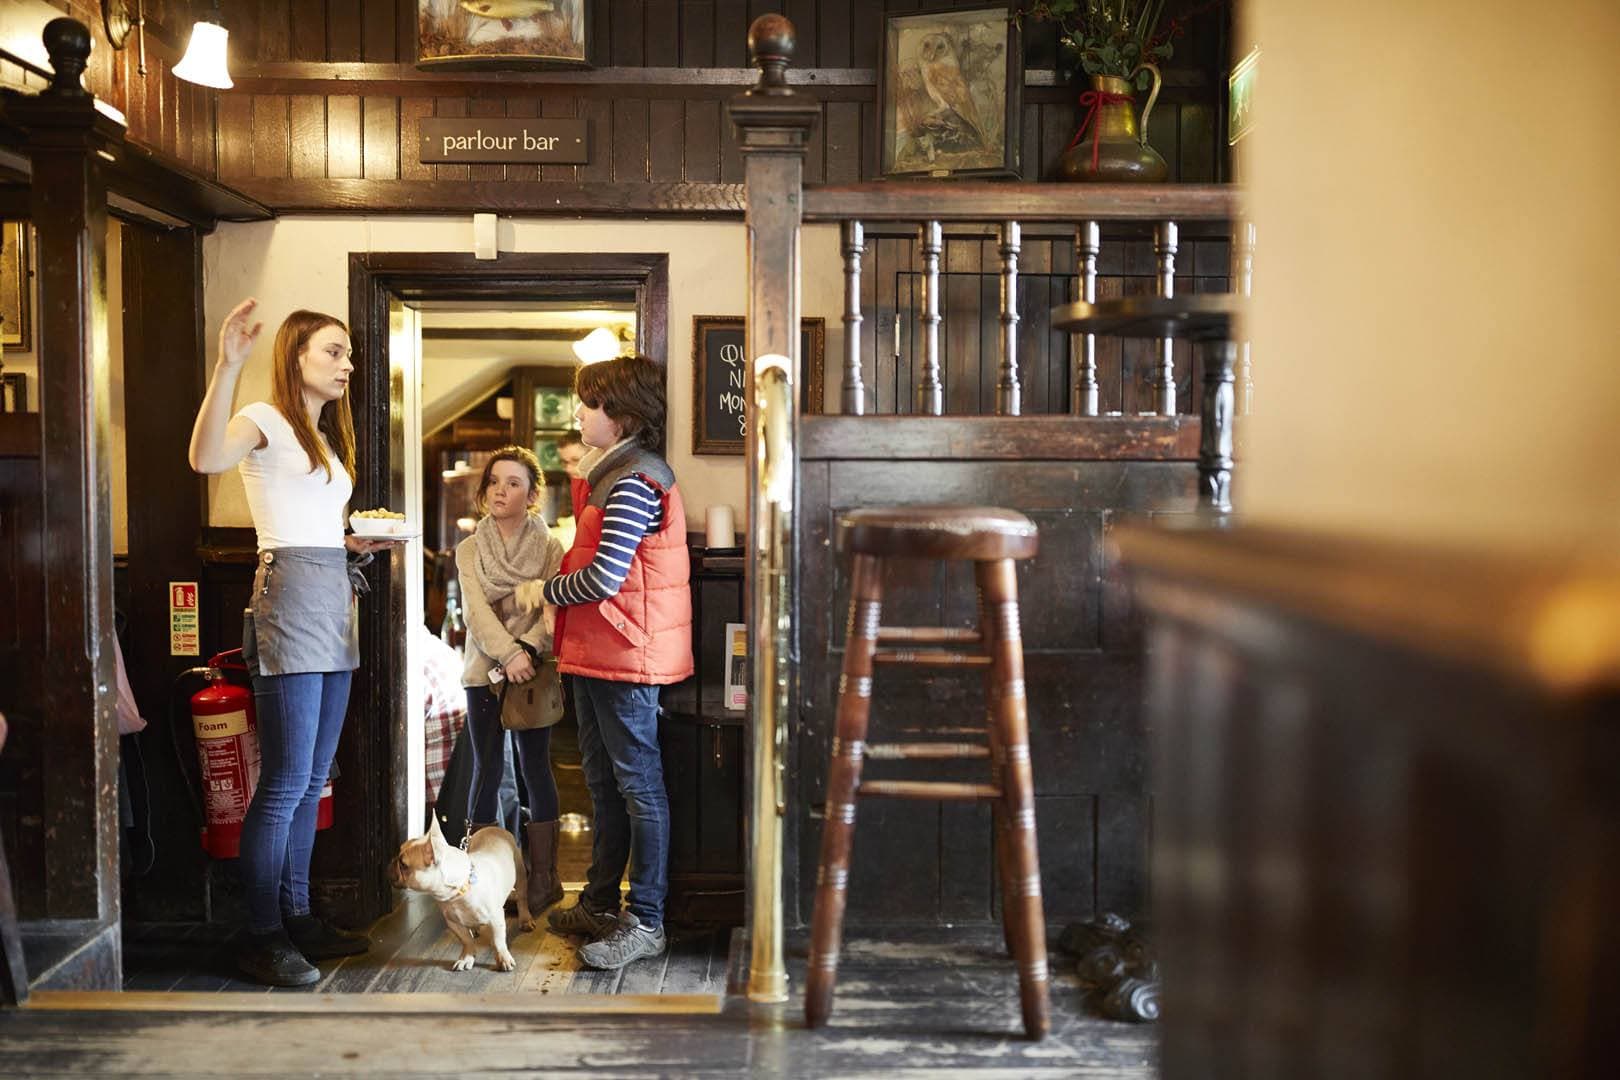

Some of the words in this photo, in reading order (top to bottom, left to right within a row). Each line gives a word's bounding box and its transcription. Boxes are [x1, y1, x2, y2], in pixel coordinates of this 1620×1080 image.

[443, 129, 517, 156] parlour
[523, 129, 559, 150] bar
[198, 721, 228, 732] Foam
